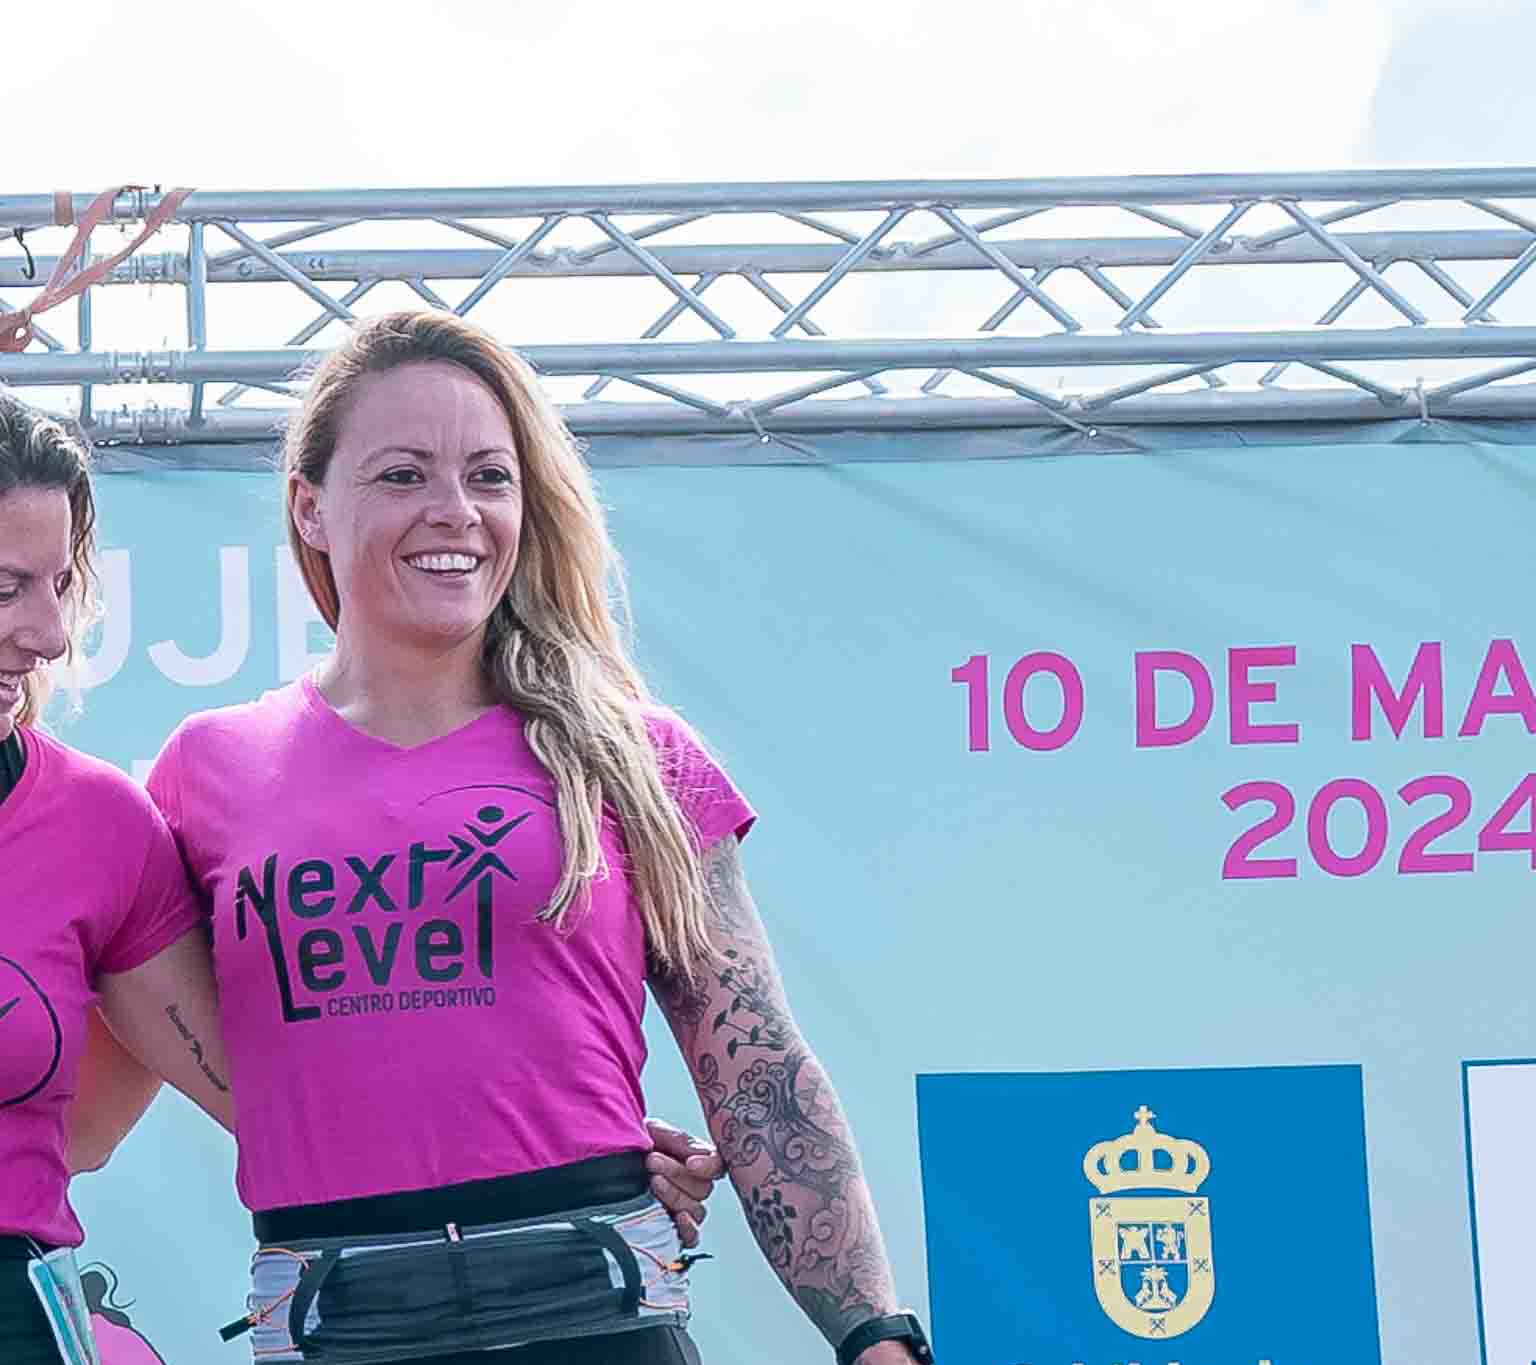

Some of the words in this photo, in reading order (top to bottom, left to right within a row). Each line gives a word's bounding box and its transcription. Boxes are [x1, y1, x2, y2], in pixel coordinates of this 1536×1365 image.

[951, 649, 1085, 753] 10
[1133, 644, 1300, 749] DE
[326, 992, 393, 1017] CENTRO
[397, 985, 497, 1012] DEPORTIVO
